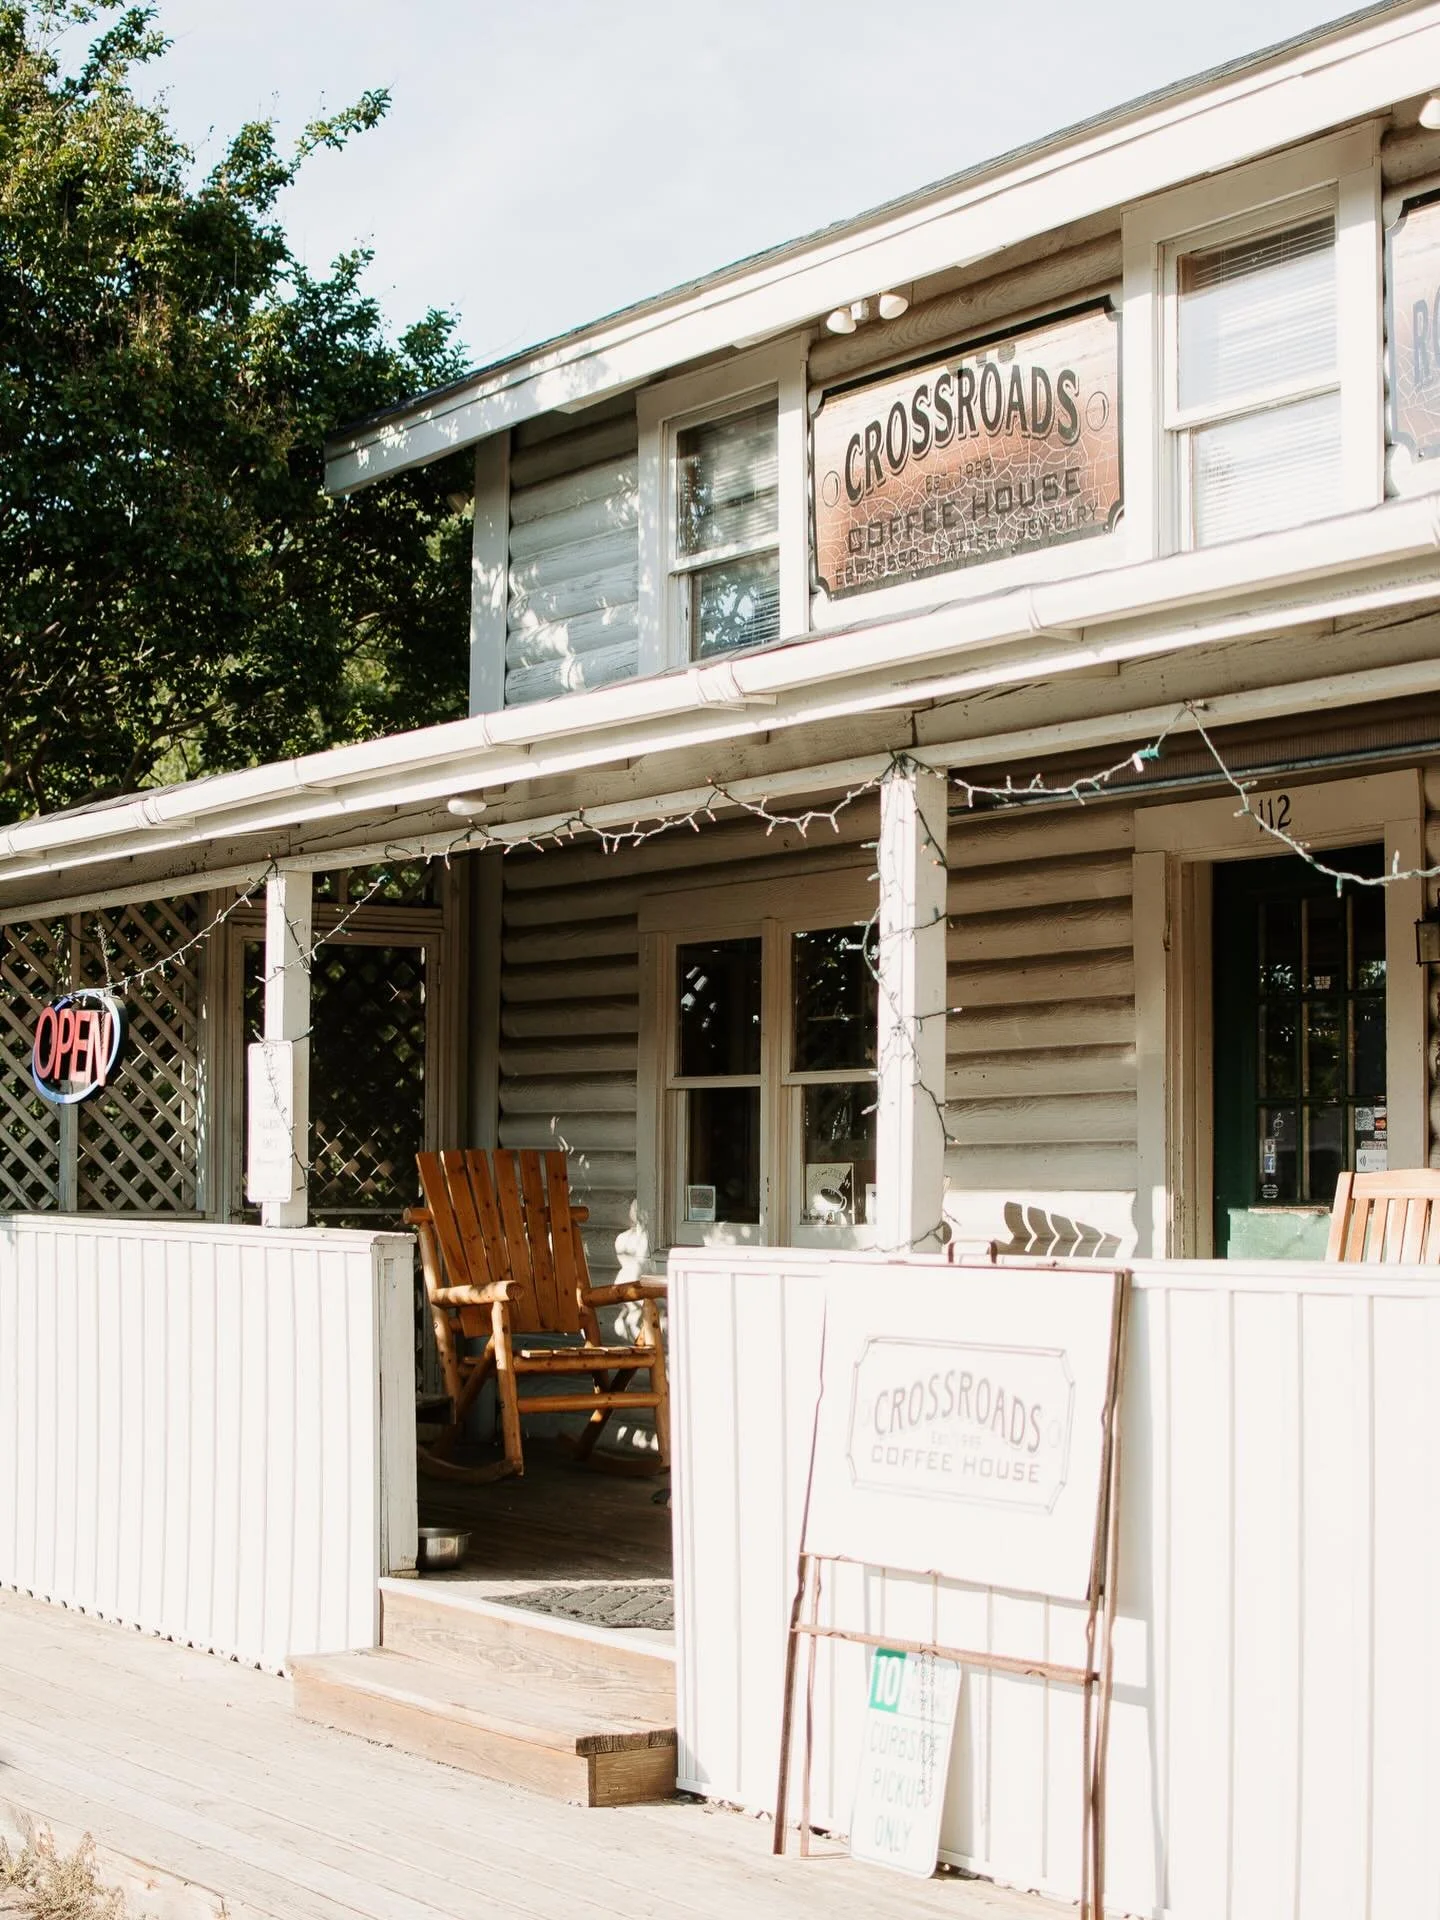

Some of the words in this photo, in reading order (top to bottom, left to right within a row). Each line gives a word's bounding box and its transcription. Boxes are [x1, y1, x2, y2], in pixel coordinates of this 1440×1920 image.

[844, 362, 1080, 506] CROSSROADS
[848, 501, 957, 553] COFFEE
[972, 467, 1081, 520] HOUSE
[1017, 503, 1098, 539] JEWELRY
[1259, 795, 1292, 833] 112
[34, 1006, 112, 1087] OPEN
[874, 1369, 1041, 1453] CROSSROADS
[871, 1445, 953, 1472] COFFEE
[963, 1456, 1040, 1484] HOUSE
[874, 1655, 901, 1707] 10
[871, 1768, 926, 1810] PICKUP
[875, 1815, 912, 1853] ONLY
